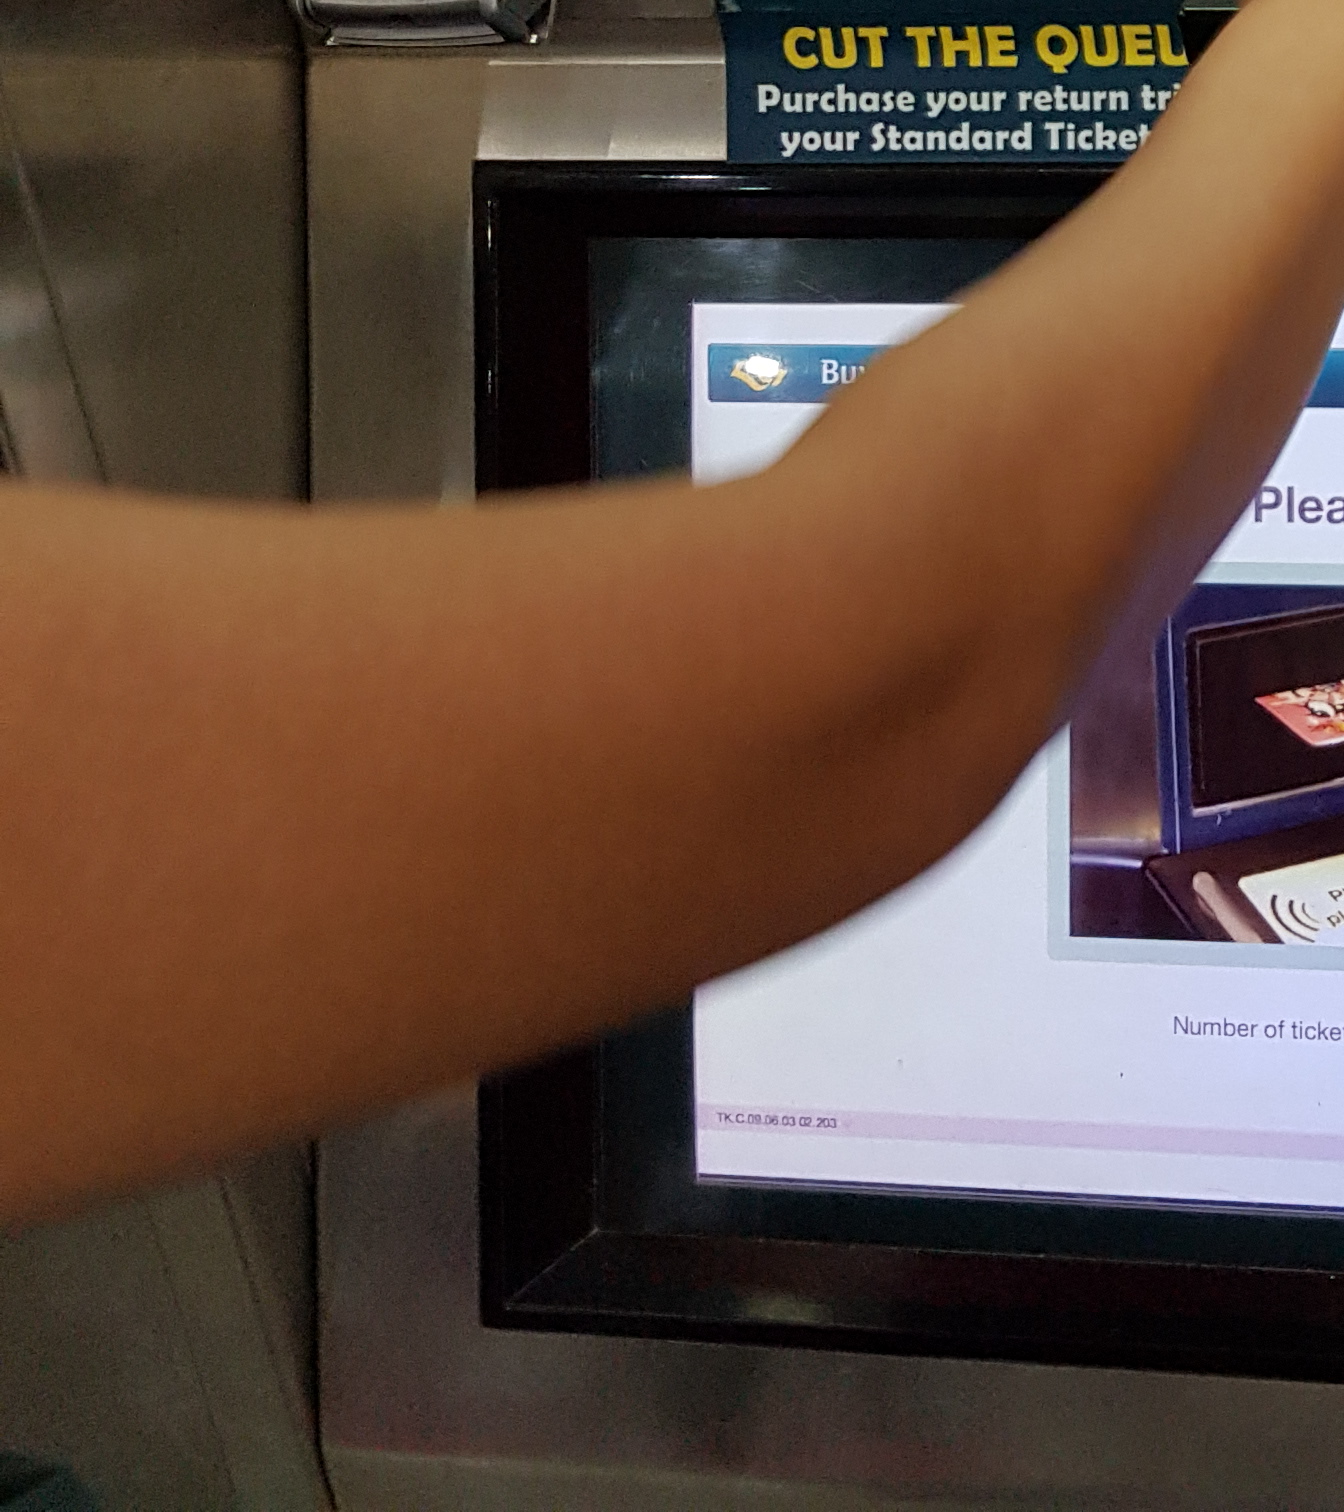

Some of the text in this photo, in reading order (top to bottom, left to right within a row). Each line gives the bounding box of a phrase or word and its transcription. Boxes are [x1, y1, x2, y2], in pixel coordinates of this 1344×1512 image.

[783, 26, 889, 69] CUT
[906, 25, 1019, 68] THE
[757, 83, 915, 113] Purchase
[925, 86, 1007, 118] your
[1018, 84, 1130, 111] return
[780, 127, 860, 157] your
[870, 122, 1033, 152] Standard
[819, 358, 866, 385] Bu
[1172, 1015, 1258, 1039] Number
[1264, 1018, 1285, 1040] of
